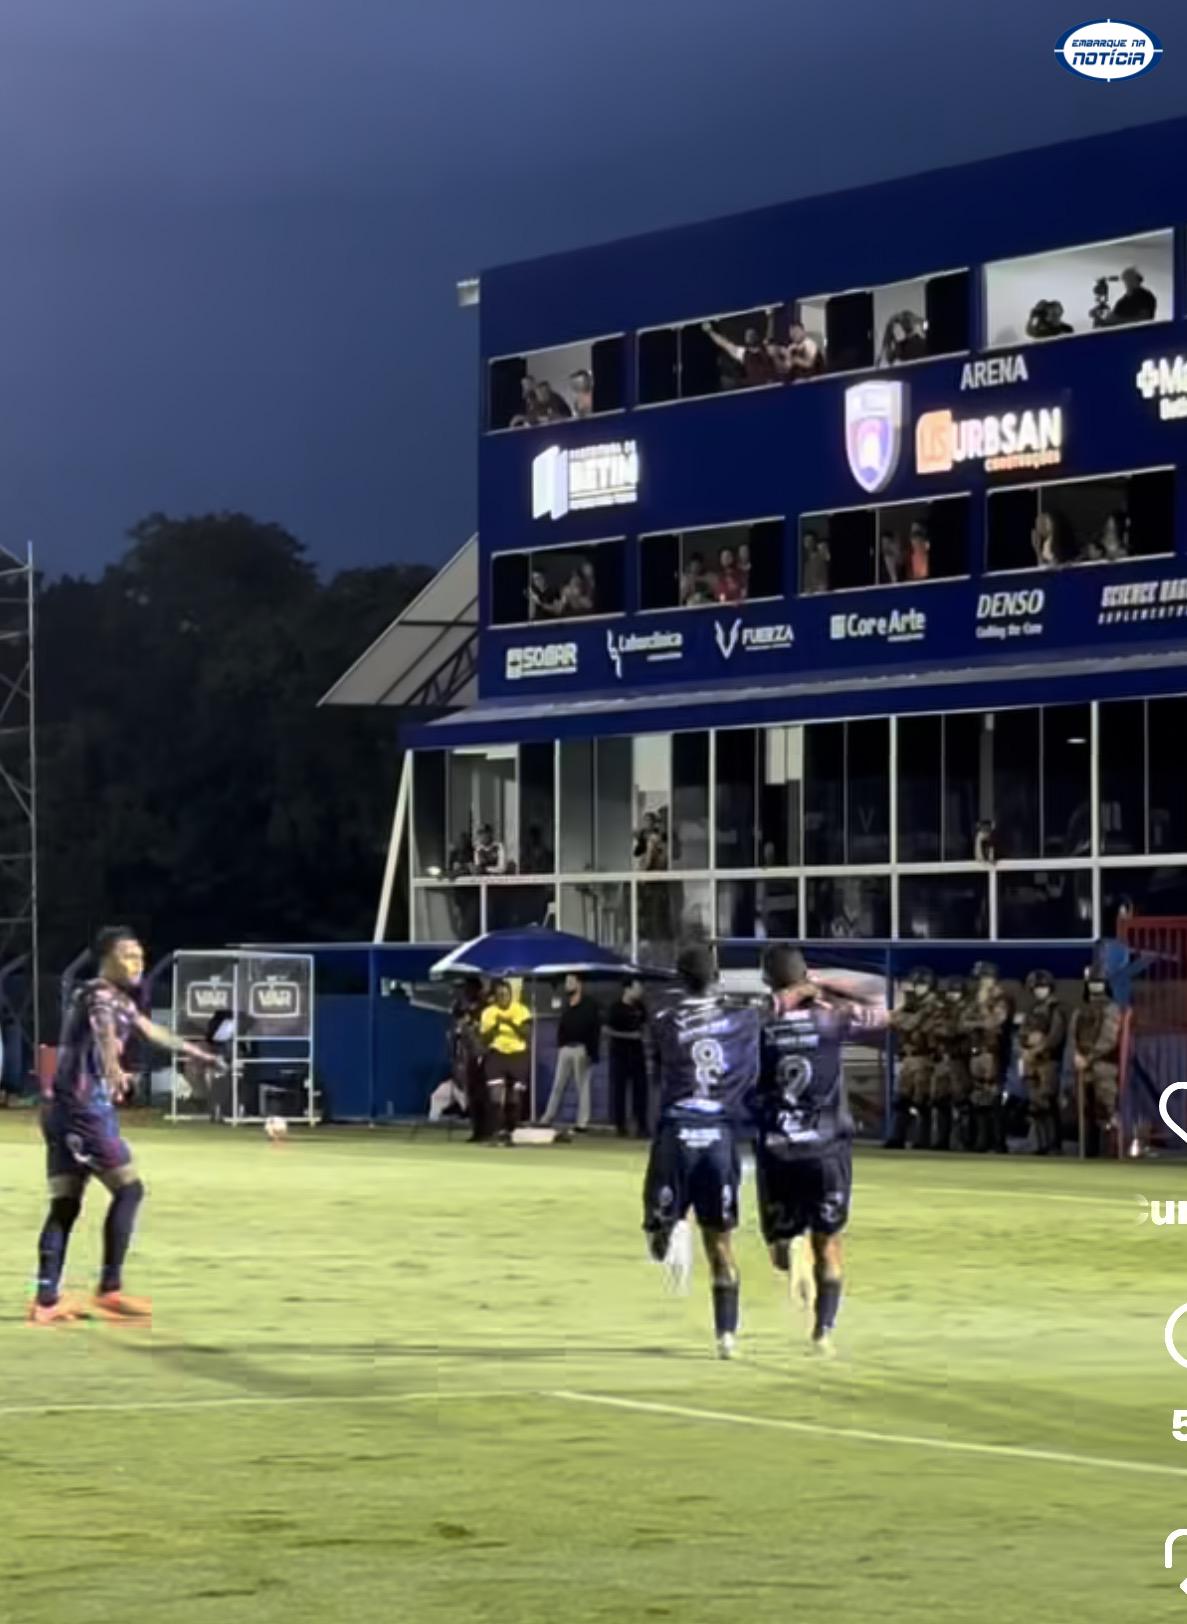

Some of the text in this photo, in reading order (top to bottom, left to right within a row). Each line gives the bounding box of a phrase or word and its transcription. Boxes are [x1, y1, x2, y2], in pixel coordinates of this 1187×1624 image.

[960, 354, 1029, 391] ARENA
[952, 406, 1062, 463] URBSAN
[976, 588, 1044, 619] DENSO
[195, 990, 228, 1008] VAR
[258, 990, 291, 1008] VAR
